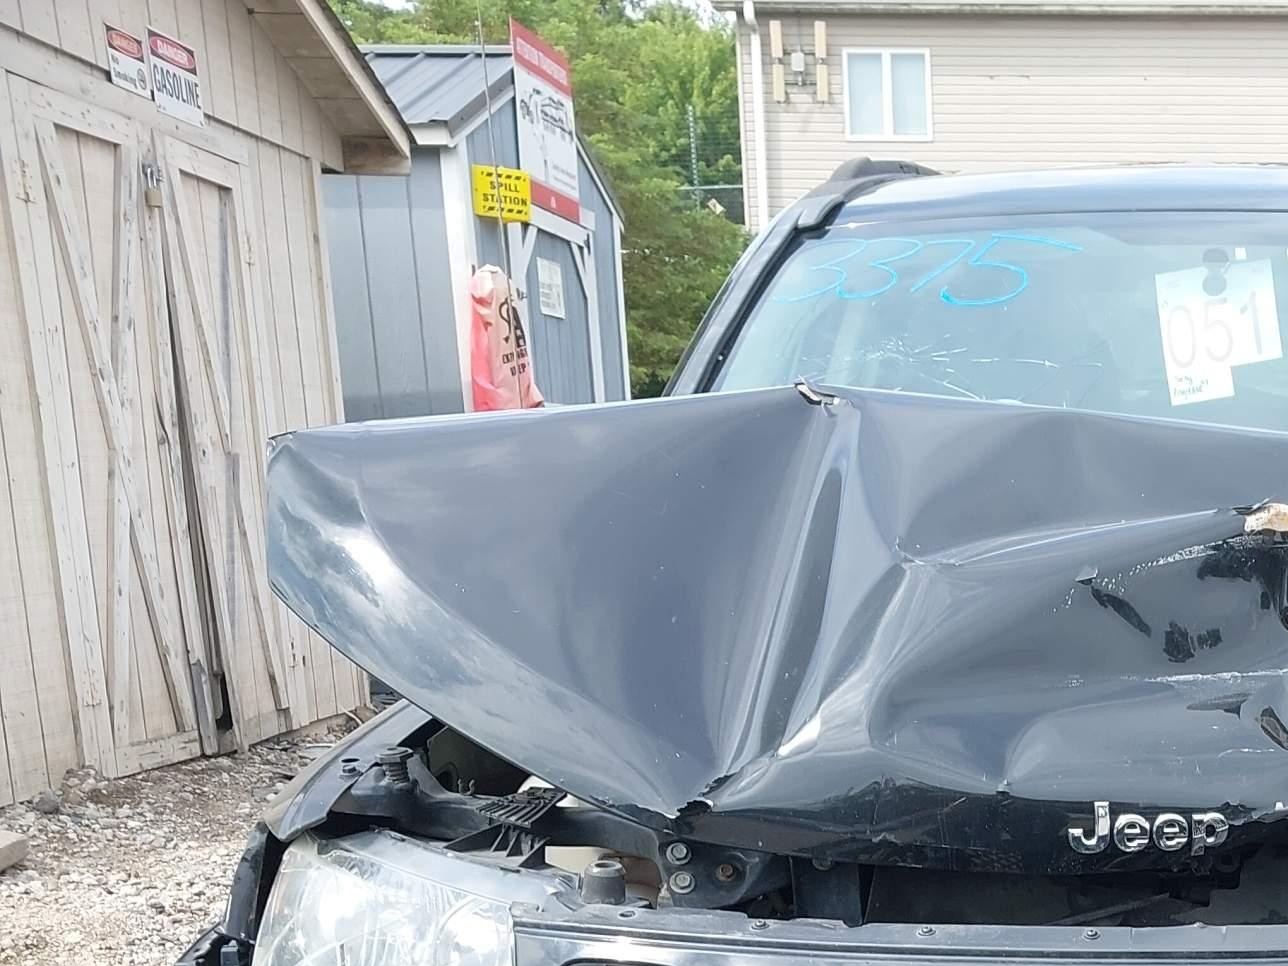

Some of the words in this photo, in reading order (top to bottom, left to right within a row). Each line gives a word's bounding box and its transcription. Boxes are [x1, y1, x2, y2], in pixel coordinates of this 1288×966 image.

[153, 63, 201, 110] GASOLINE
[489, 181, 520, 193] SPILL
[768, 232, 1083, 306] 3375
[1166, 290, 1264, 369] 051
[1068, 801, 1229, 857] Jeep
